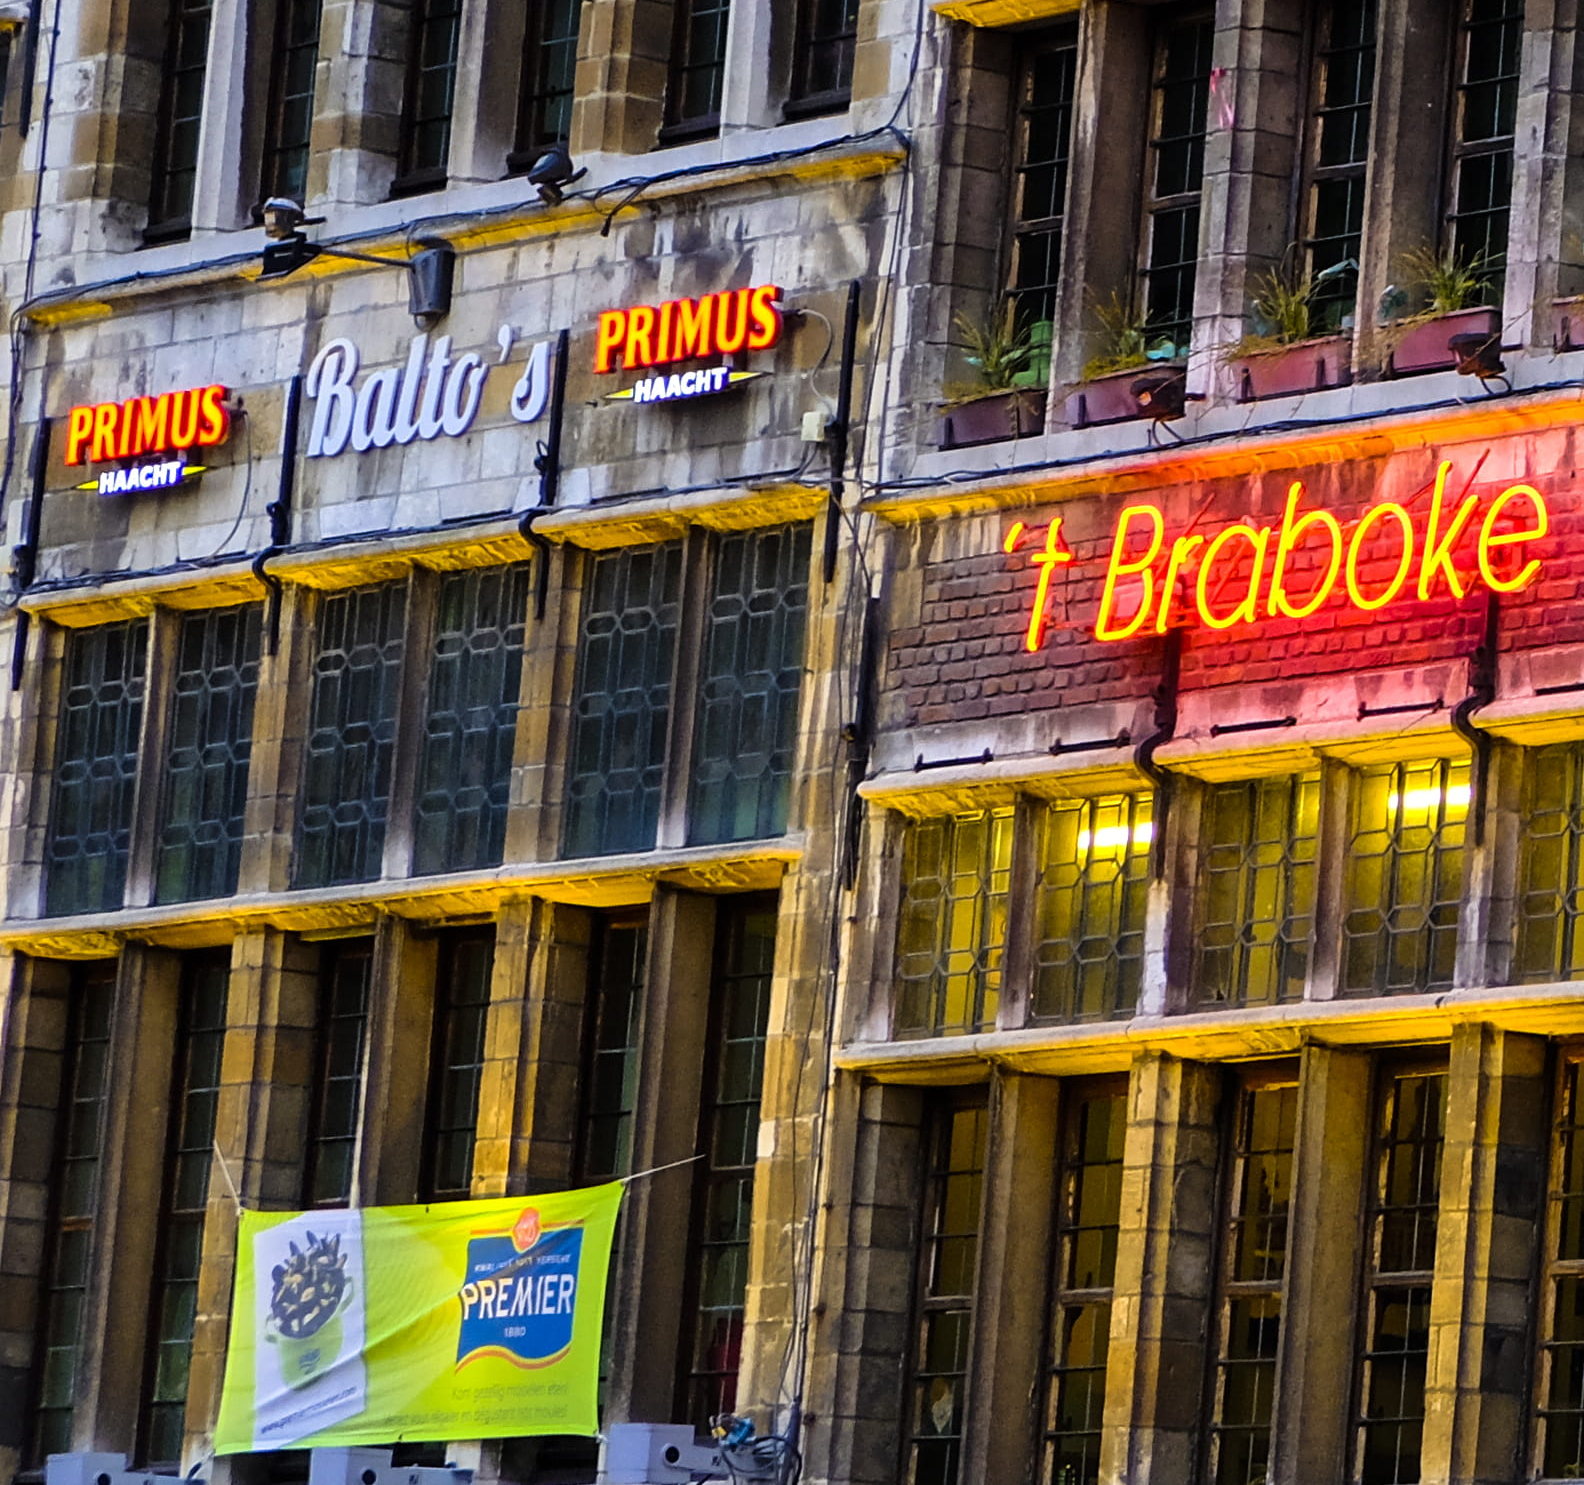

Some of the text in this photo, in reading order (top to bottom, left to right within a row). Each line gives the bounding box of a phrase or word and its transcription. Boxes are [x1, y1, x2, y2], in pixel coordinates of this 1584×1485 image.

[594, 284, 784, 373] PRIMUS
[65, 384, 232, 466] PRIMUS
[307, 323, 549, 458] Balto's
[634, 367, 730, 403] HAACHT
[99, 461, 184, 495] HAACHT
[1094, 460, 1549, 641] Braboke
[460, 1273, 575, 1320] PREMIER
